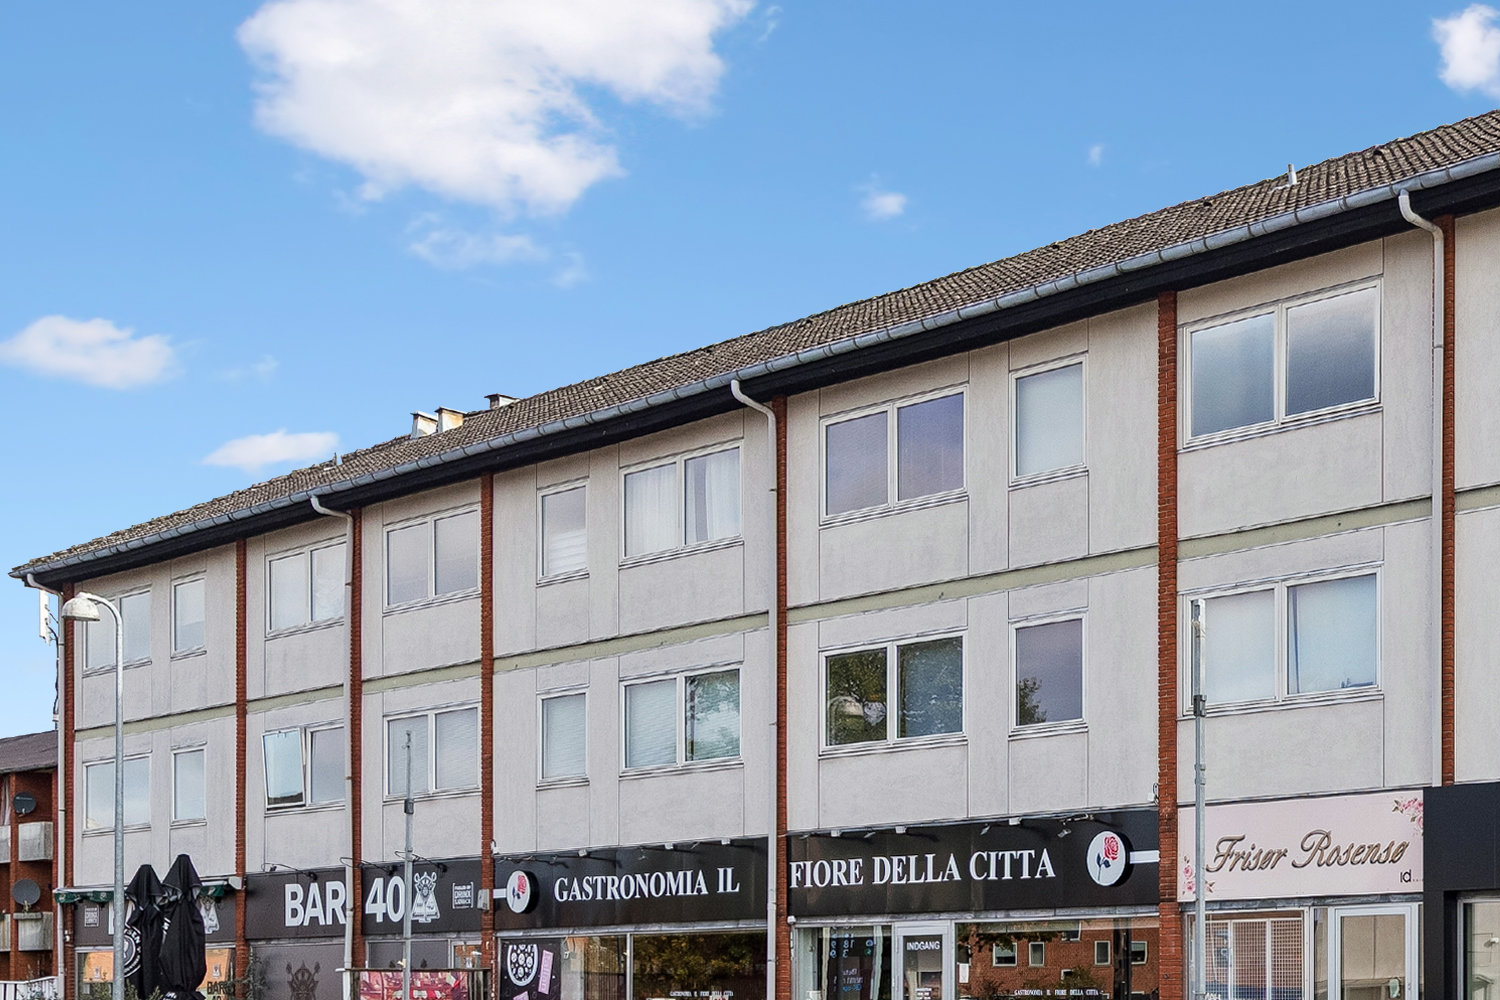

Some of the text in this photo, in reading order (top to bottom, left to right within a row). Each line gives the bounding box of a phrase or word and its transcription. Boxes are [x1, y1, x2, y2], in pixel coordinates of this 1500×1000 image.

[554, 867, 741, 902] GASTRONOMIA IL
[789, 848, 1056, 888] FIORE DELLA CITTA
[285, 880, 346, 927] BAR
[365, 876, 406, 923] 40
[906, 941, 940, 951] INDGANG
[207, 981, 226, 995] BAR
